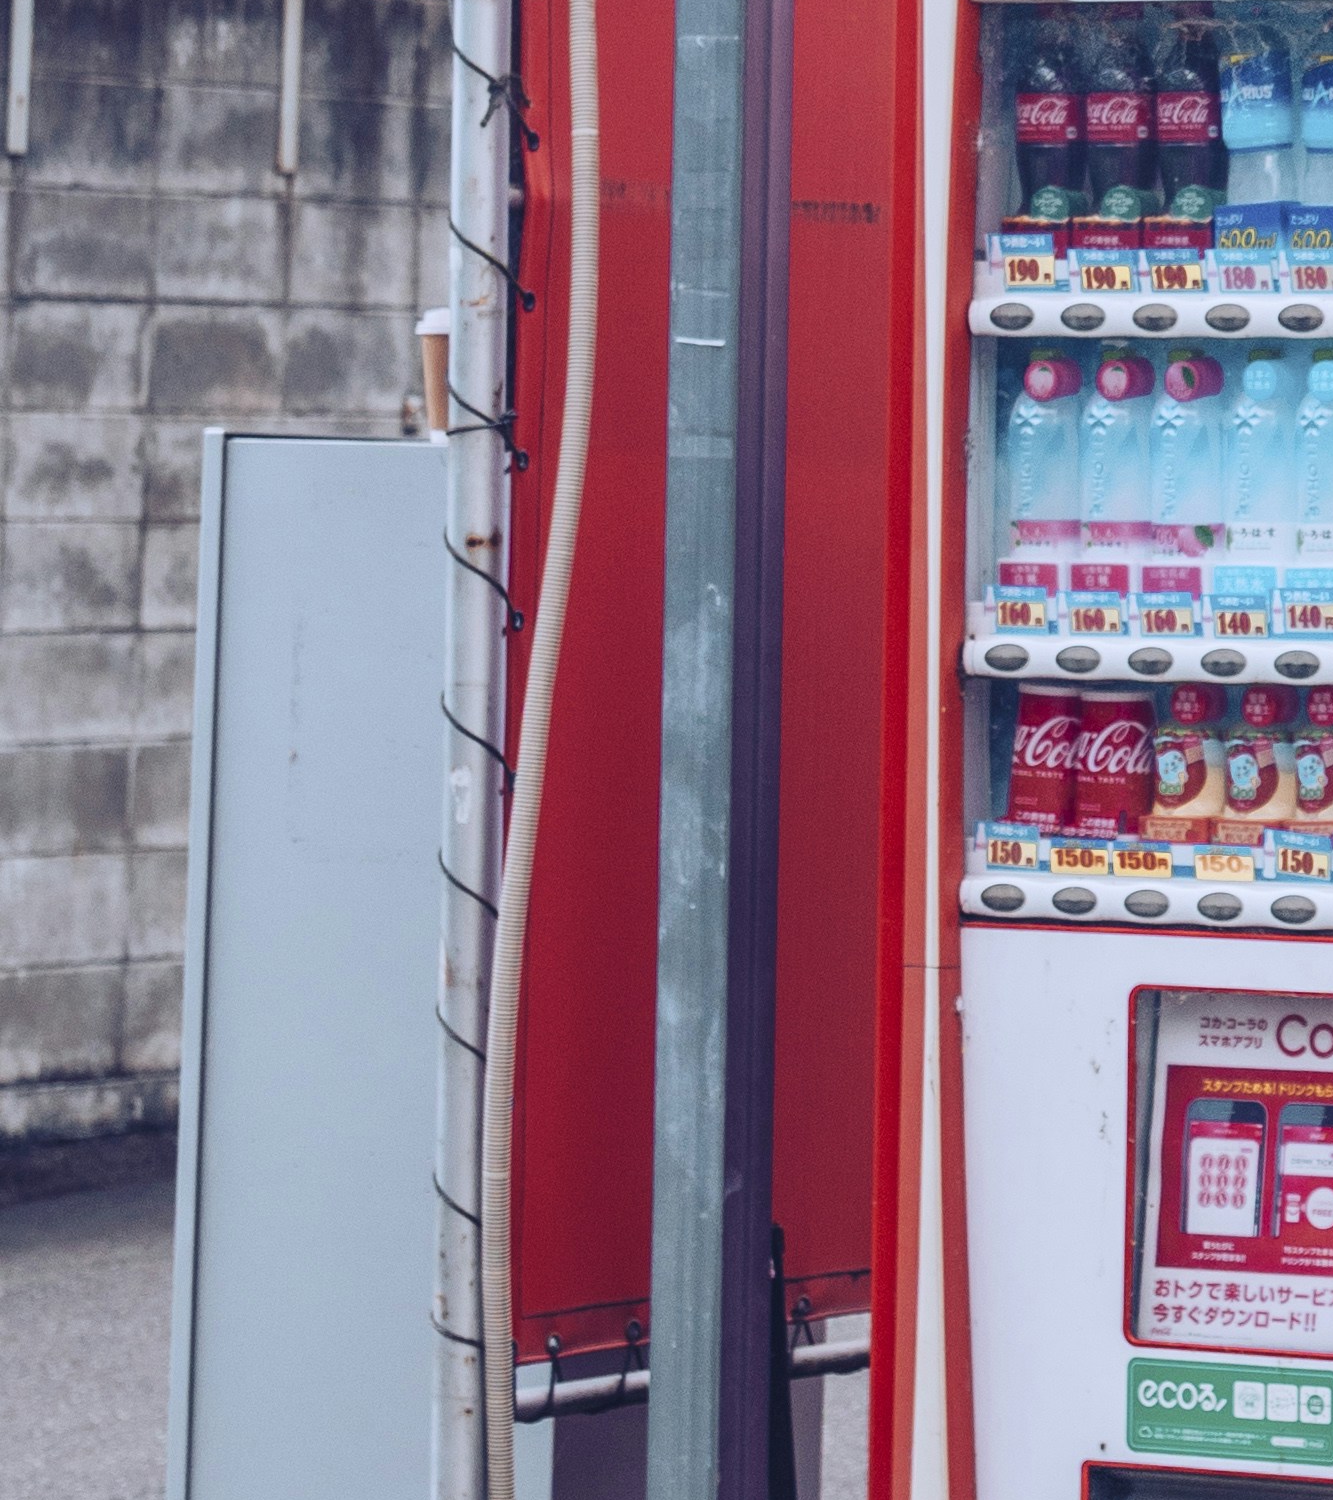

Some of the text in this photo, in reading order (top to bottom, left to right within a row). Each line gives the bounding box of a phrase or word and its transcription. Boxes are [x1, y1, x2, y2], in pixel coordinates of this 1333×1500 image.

[1199, 1015, 1268, 1031] コカ・コーラの
[1198, 1034, 1264, 1050] スマホアプリ
[1152, 1303, 1318, 1333] 今すぐダウンロード!!
